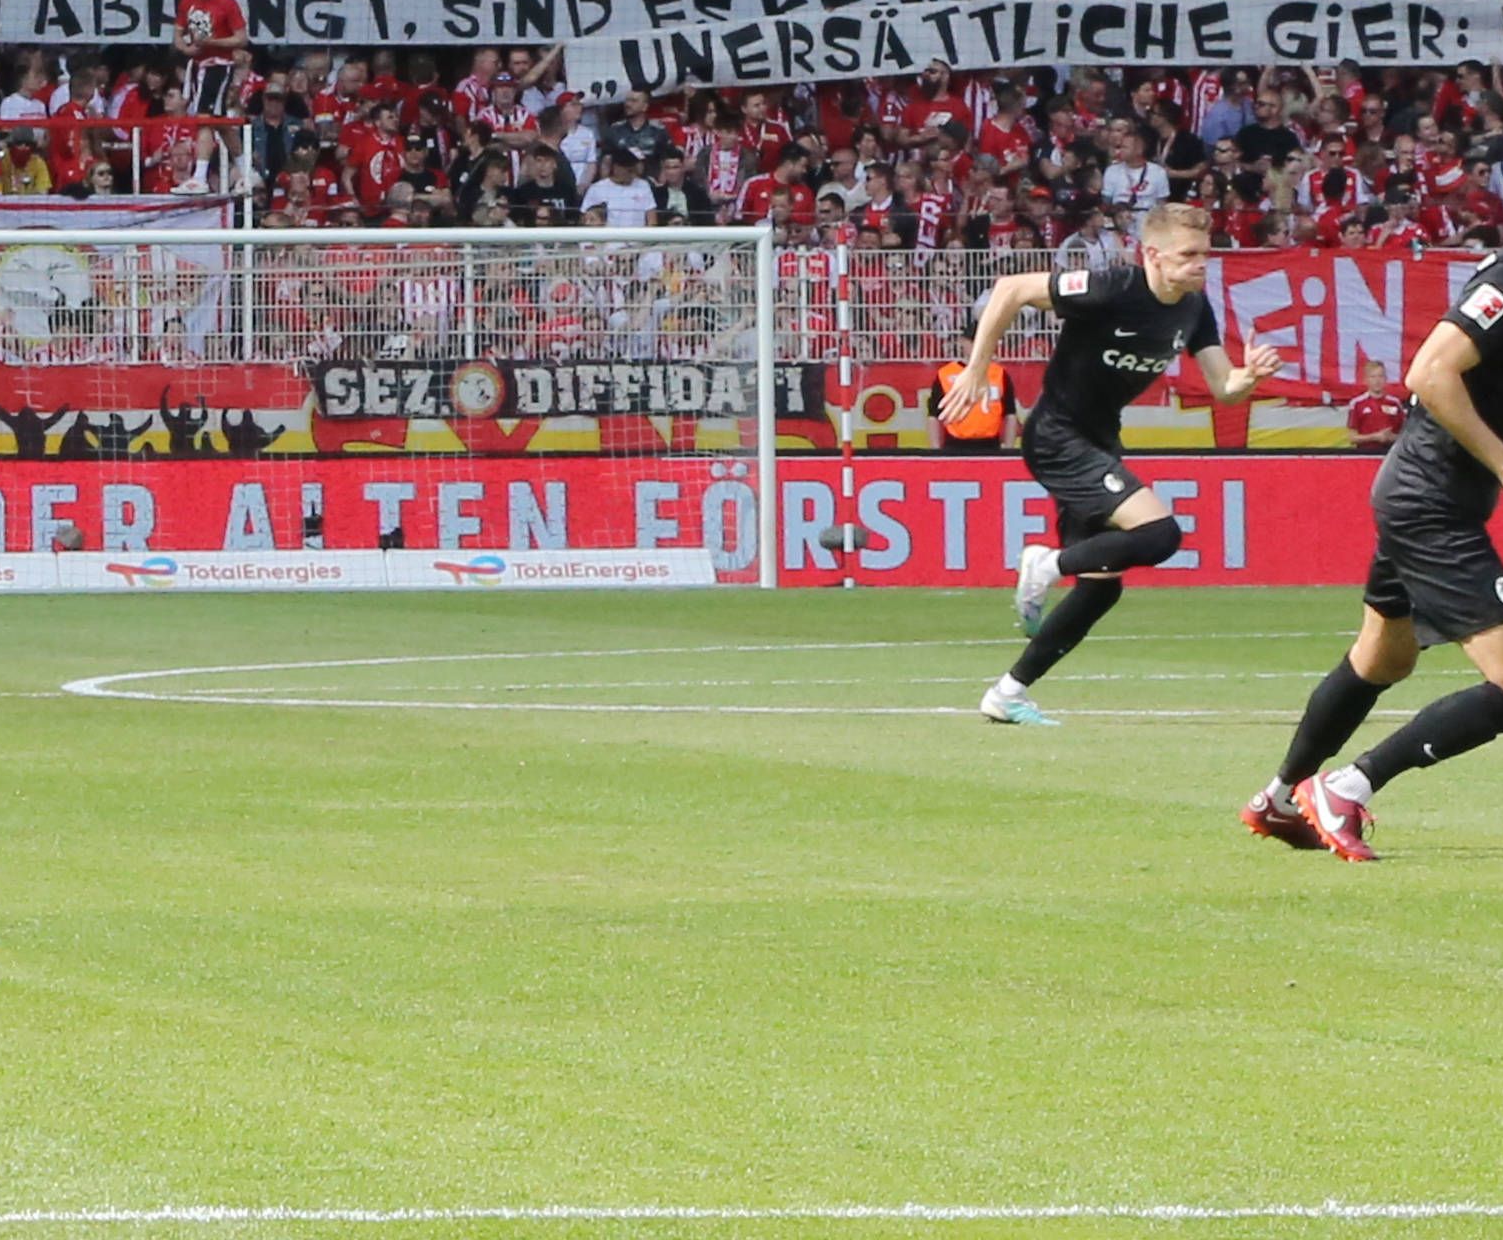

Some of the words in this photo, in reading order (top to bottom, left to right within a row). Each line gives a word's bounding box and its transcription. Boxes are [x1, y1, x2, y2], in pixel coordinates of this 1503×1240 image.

[635, 462, 1246, 572] FÖRSTEEI
[183, 561, 342, 584] TotalEnergies
[512, 560, 671, 582] TotalEnergies
